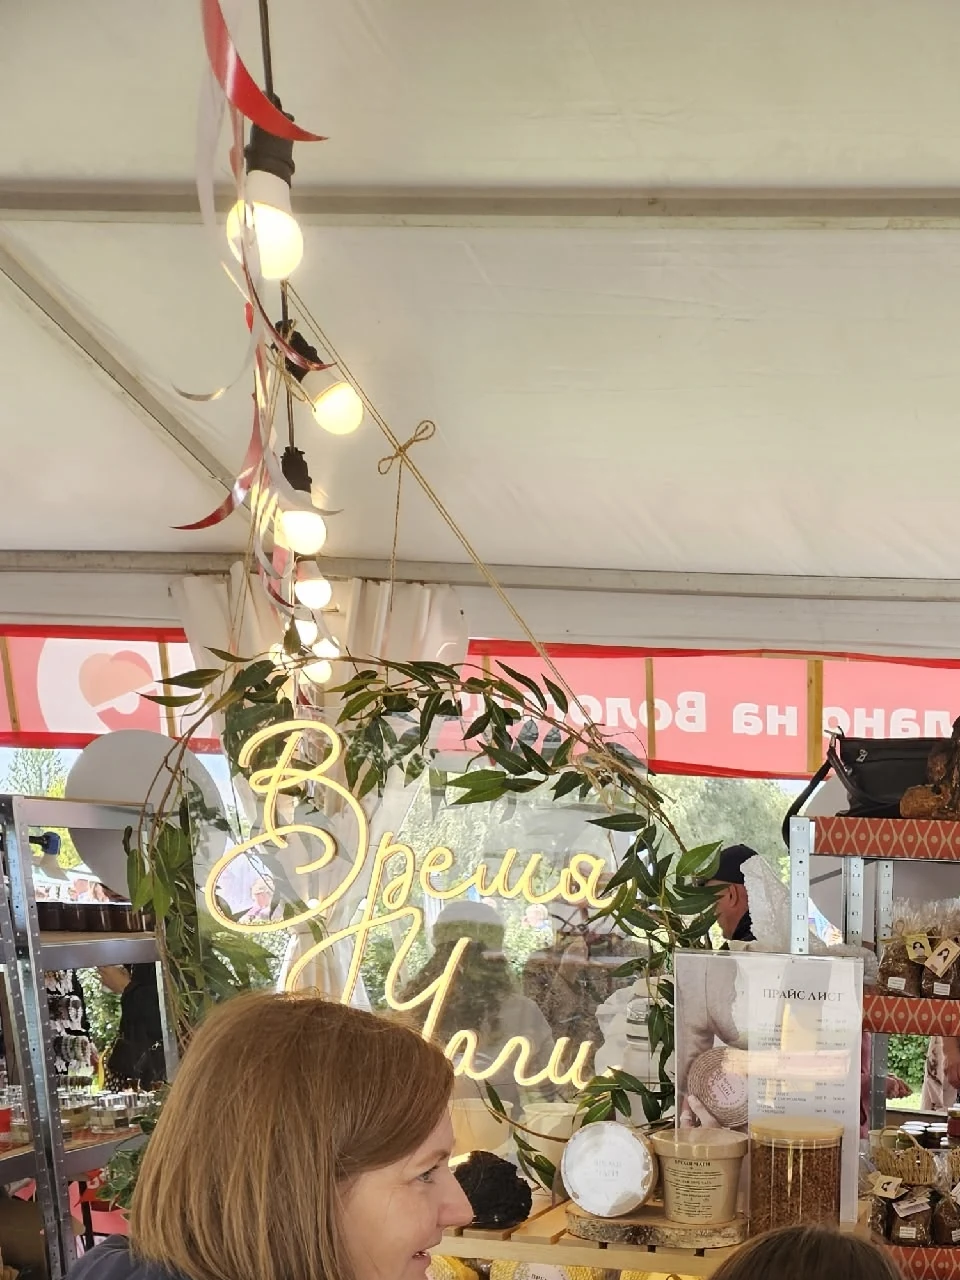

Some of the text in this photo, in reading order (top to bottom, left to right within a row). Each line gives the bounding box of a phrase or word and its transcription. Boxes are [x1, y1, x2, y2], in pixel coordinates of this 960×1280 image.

[204, 718, 624, 1005] Время
[284, 905, 622, 1090] Чаги
[763, 988, 805, 1001] ПРАЙС
